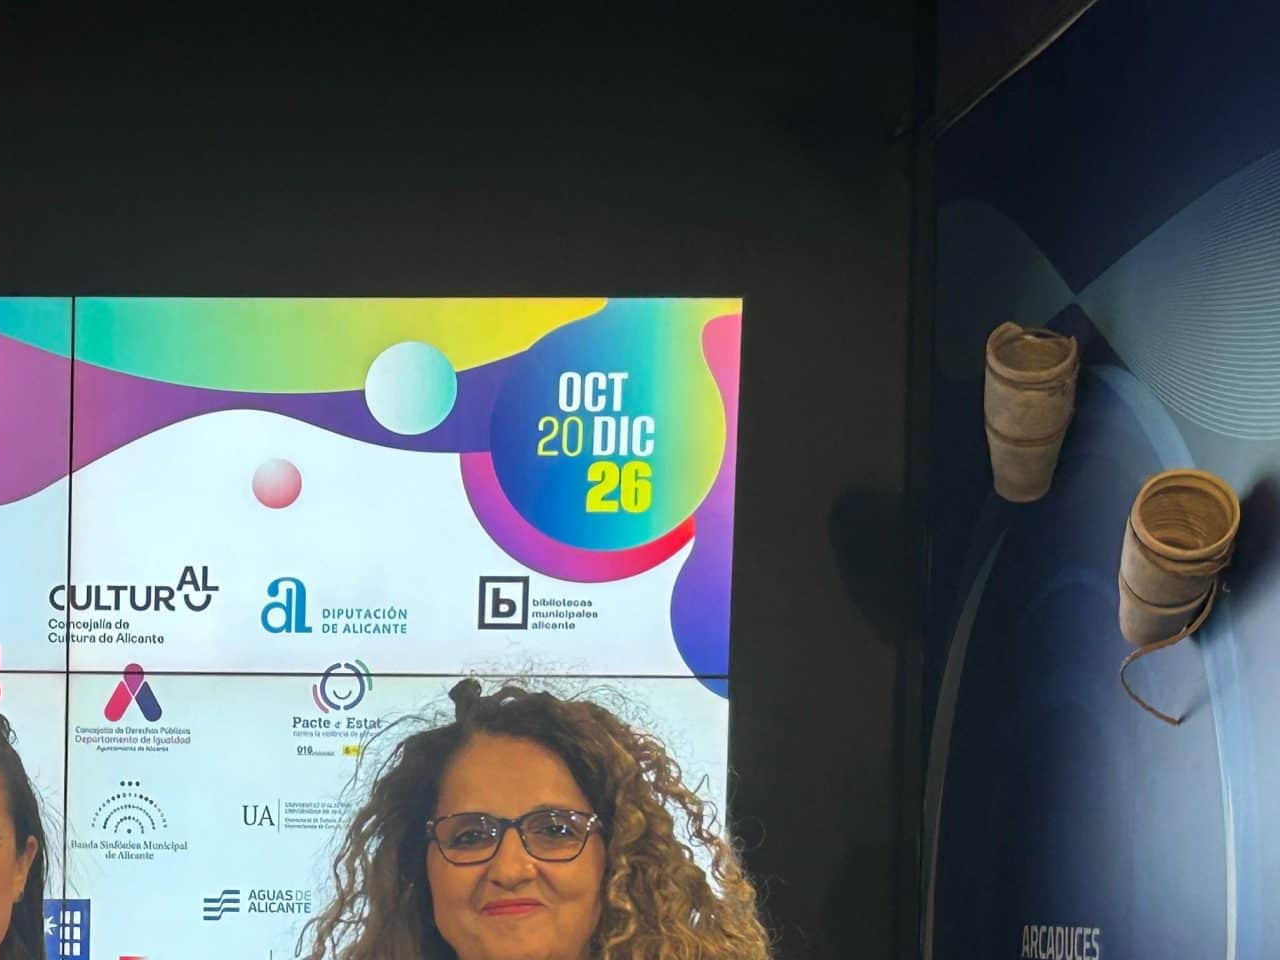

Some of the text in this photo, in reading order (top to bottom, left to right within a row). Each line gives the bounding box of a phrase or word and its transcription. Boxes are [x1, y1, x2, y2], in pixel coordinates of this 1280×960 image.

[559, 371, 629, 412] OCT
[537, 416, 656, 456] 20 DIC
[586, 461, 653, 512] 26
[322, 607, 408, 619] DIPUTACIÓN
[115, 619, 130, 629] de
[322, 624, 407, 634] DE ALICANTE
[532, 622, 576, 630] alicante
[99, 633, 113, 643] de
[116, 633, 165, 644] Alicante
[293, 717, 330, 728] Pacte
[346, 717, 381, 729] Estat
[242, 805, 275, 826] UA
[248, 889, 312, 901] AGUAS DE
[248, 902, 312, 914] ALICANTE
